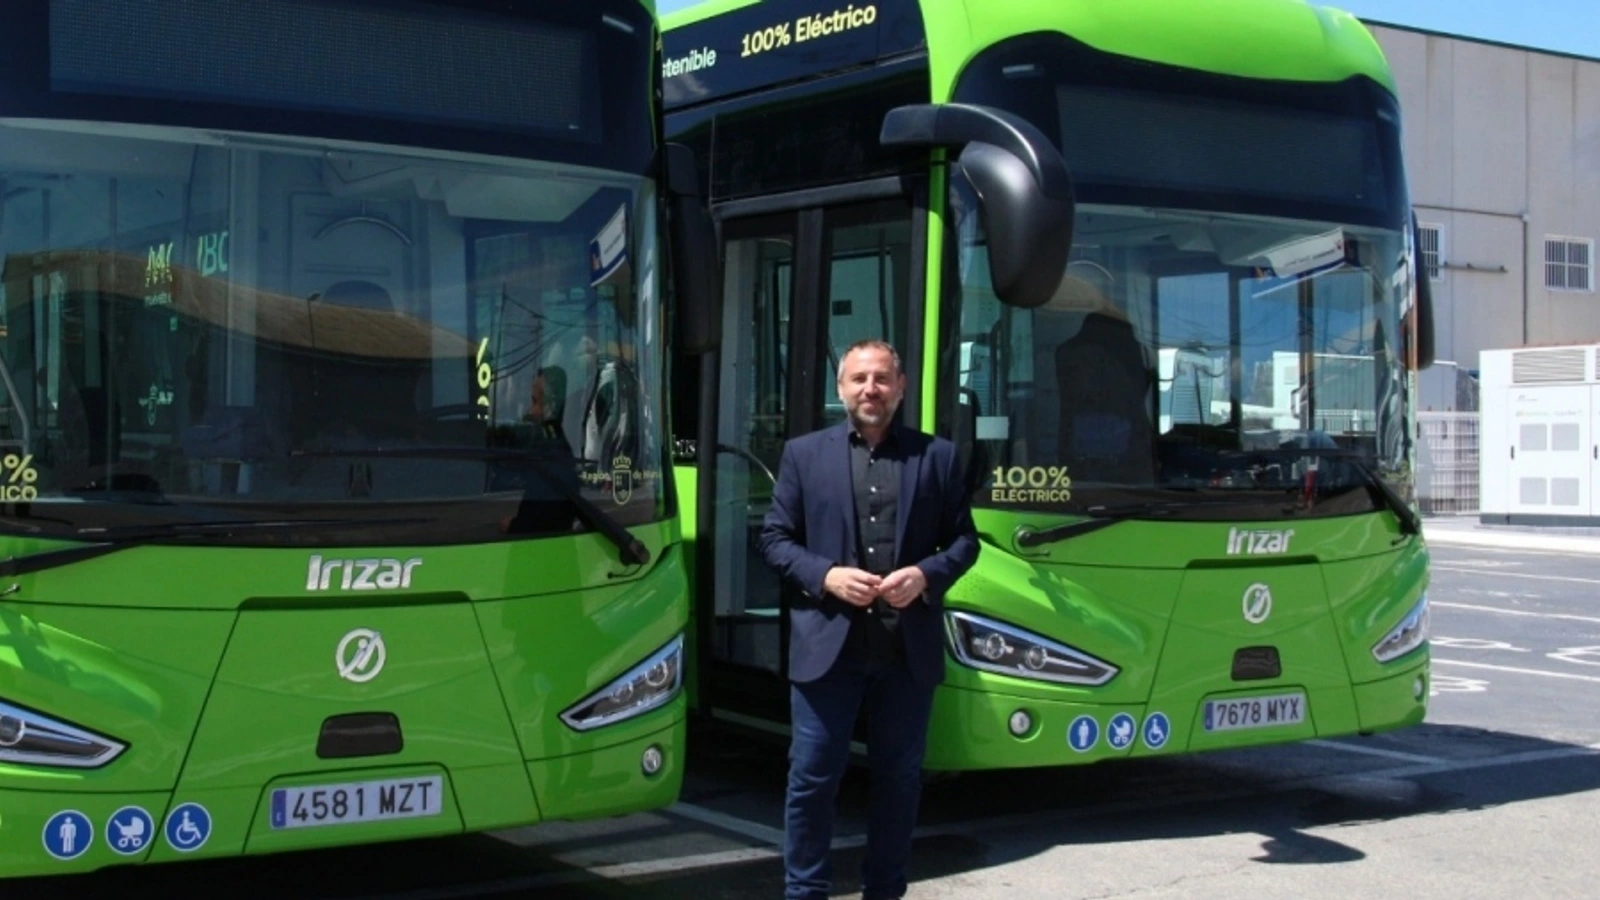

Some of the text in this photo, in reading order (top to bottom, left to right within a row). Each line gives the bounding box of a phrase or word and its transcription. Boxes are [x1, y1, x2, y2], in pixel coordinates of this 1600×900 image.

[740, 22, 791, 58] 100%
[795, 4, 877, 42] Eléctrico
[991, 465, 1071, 488] 100%
[1226, 526, 1295, 555] Irizar
[306, 555, 423, 591] Irizar
[1216, 697, 1300, 727] 7678 MYX
[292, 781, 433, 822] 4581 MZT
